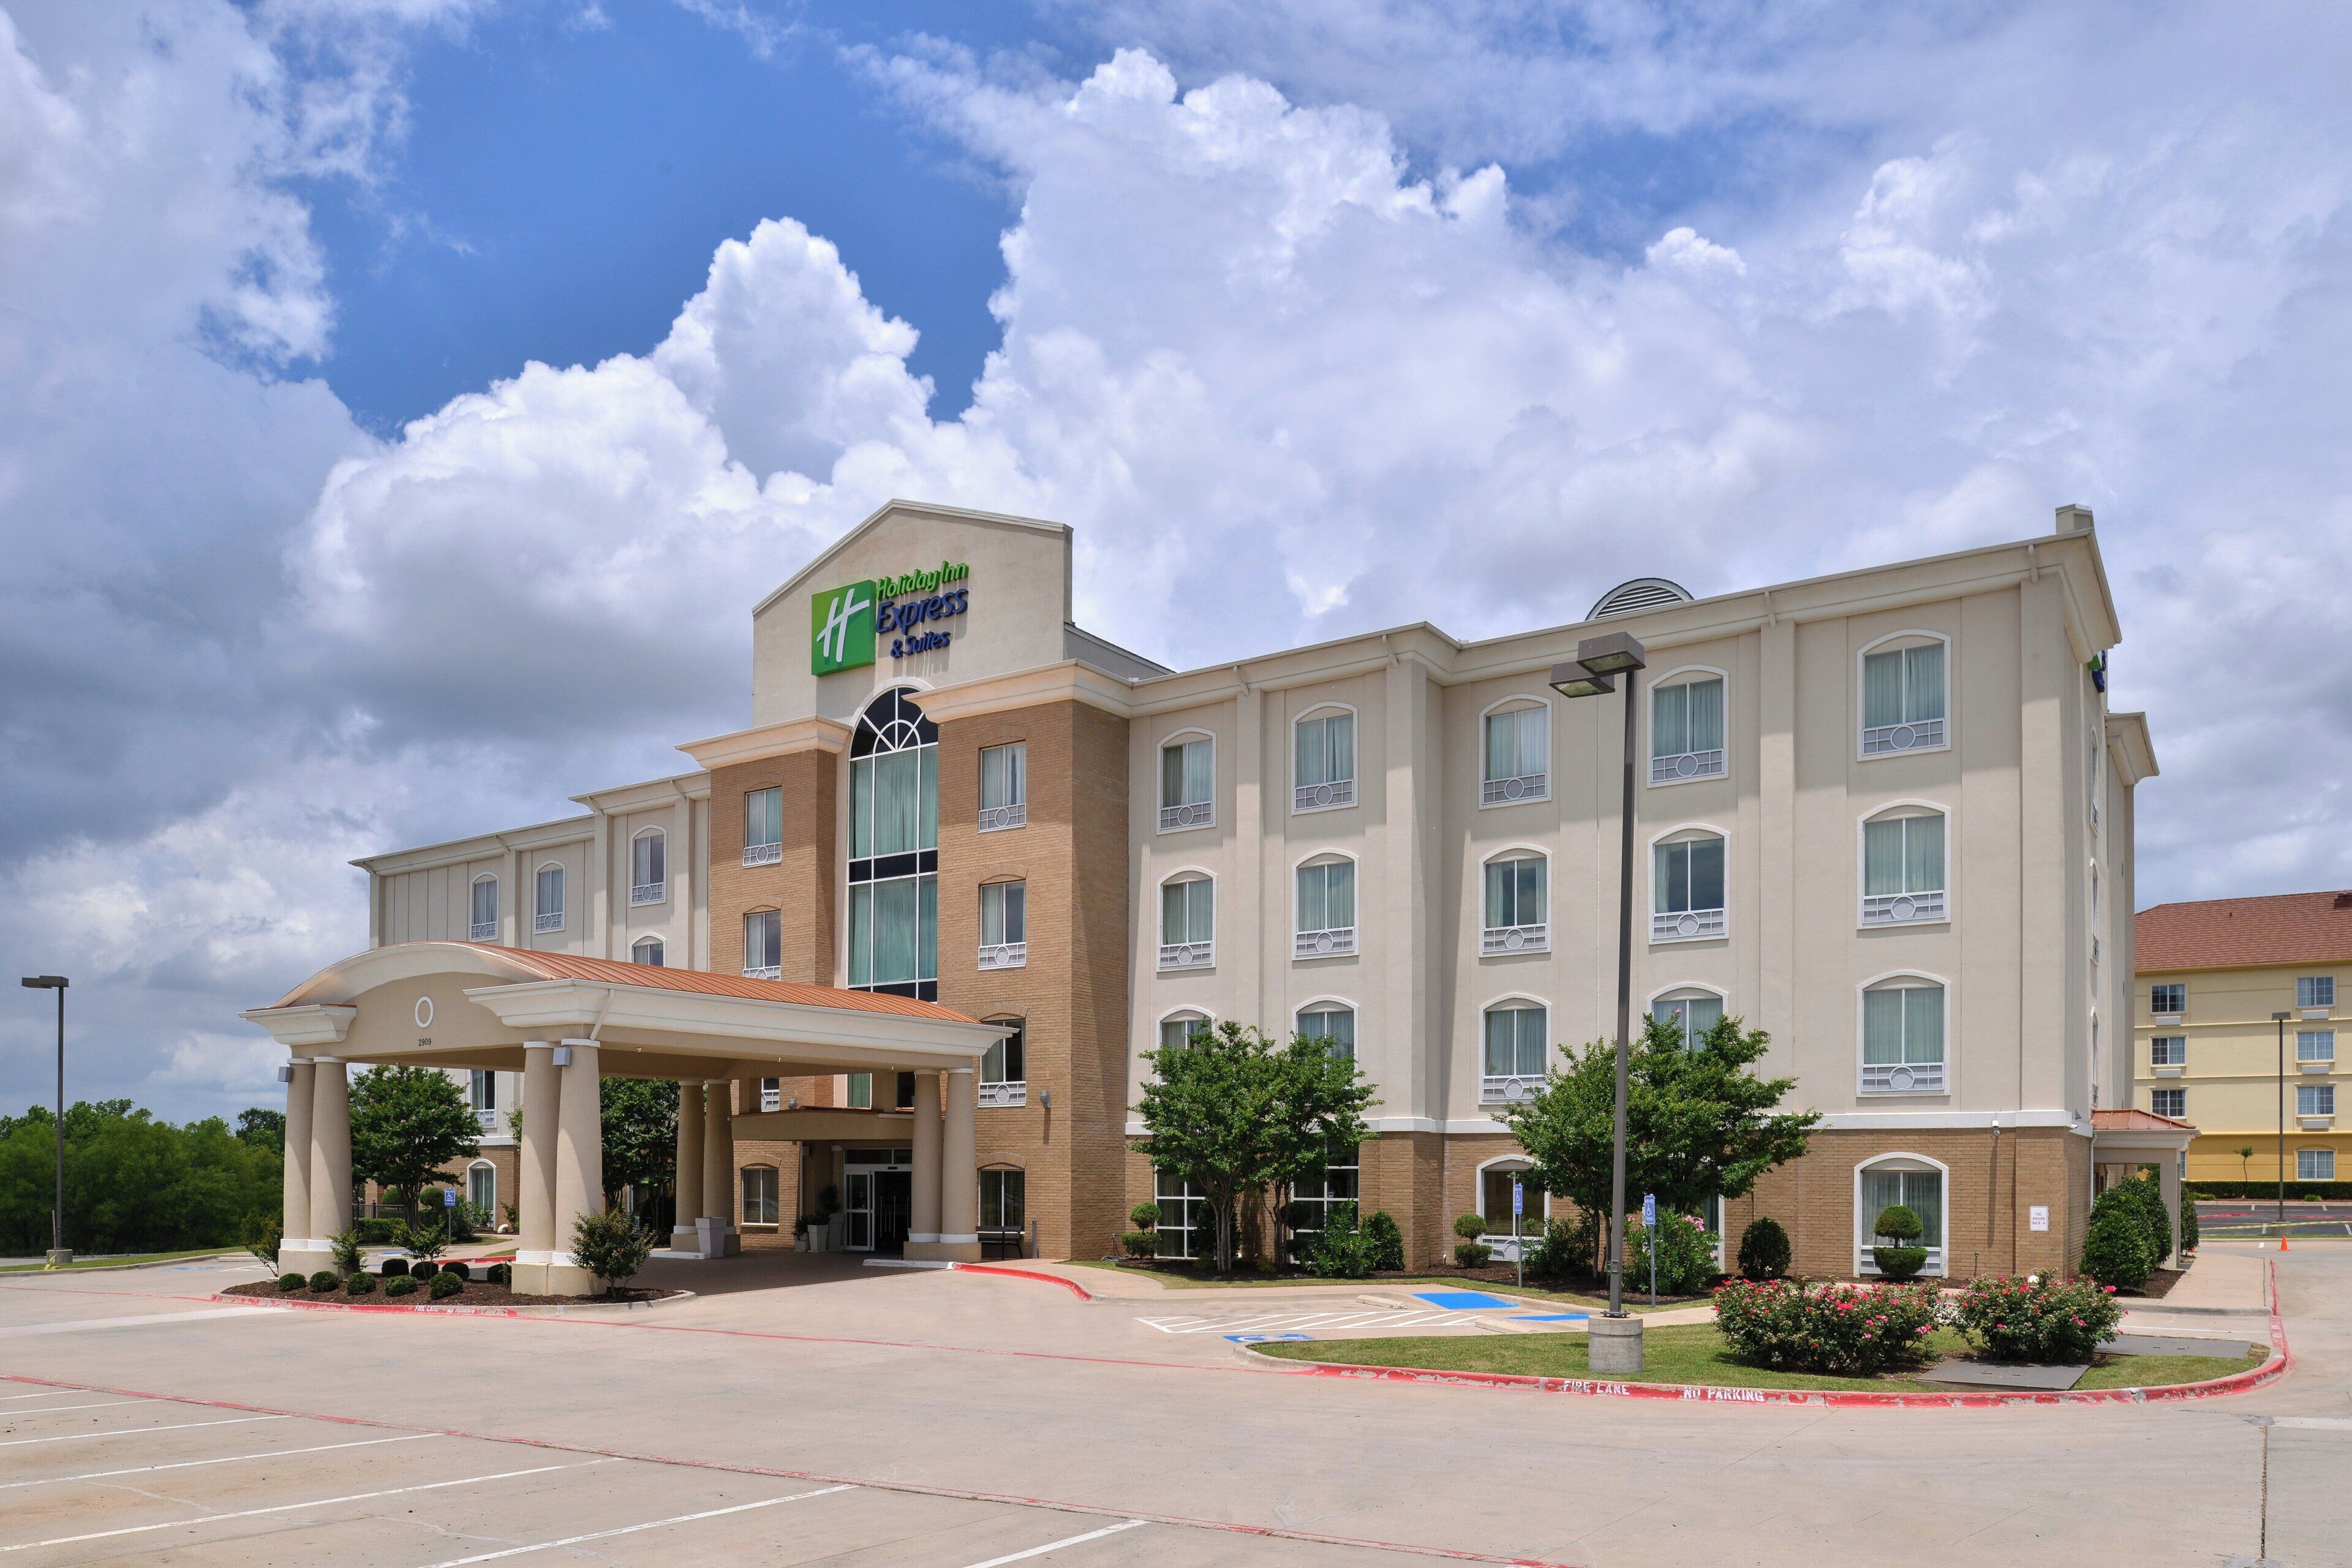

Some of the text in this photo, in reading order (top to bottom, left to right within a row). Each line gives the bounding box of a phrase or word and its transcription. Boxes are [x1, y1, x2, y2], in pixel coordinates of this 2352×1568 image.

[876, 560, 969, 600] Holiday Inn
[876, 589, 969, 635] Express
[890, 631, 951, 658] & Suites
[418, 1038, 431, 1046] 2909
[1563, 1380, 1765, 1402] FIRE LANE NO PARKING
